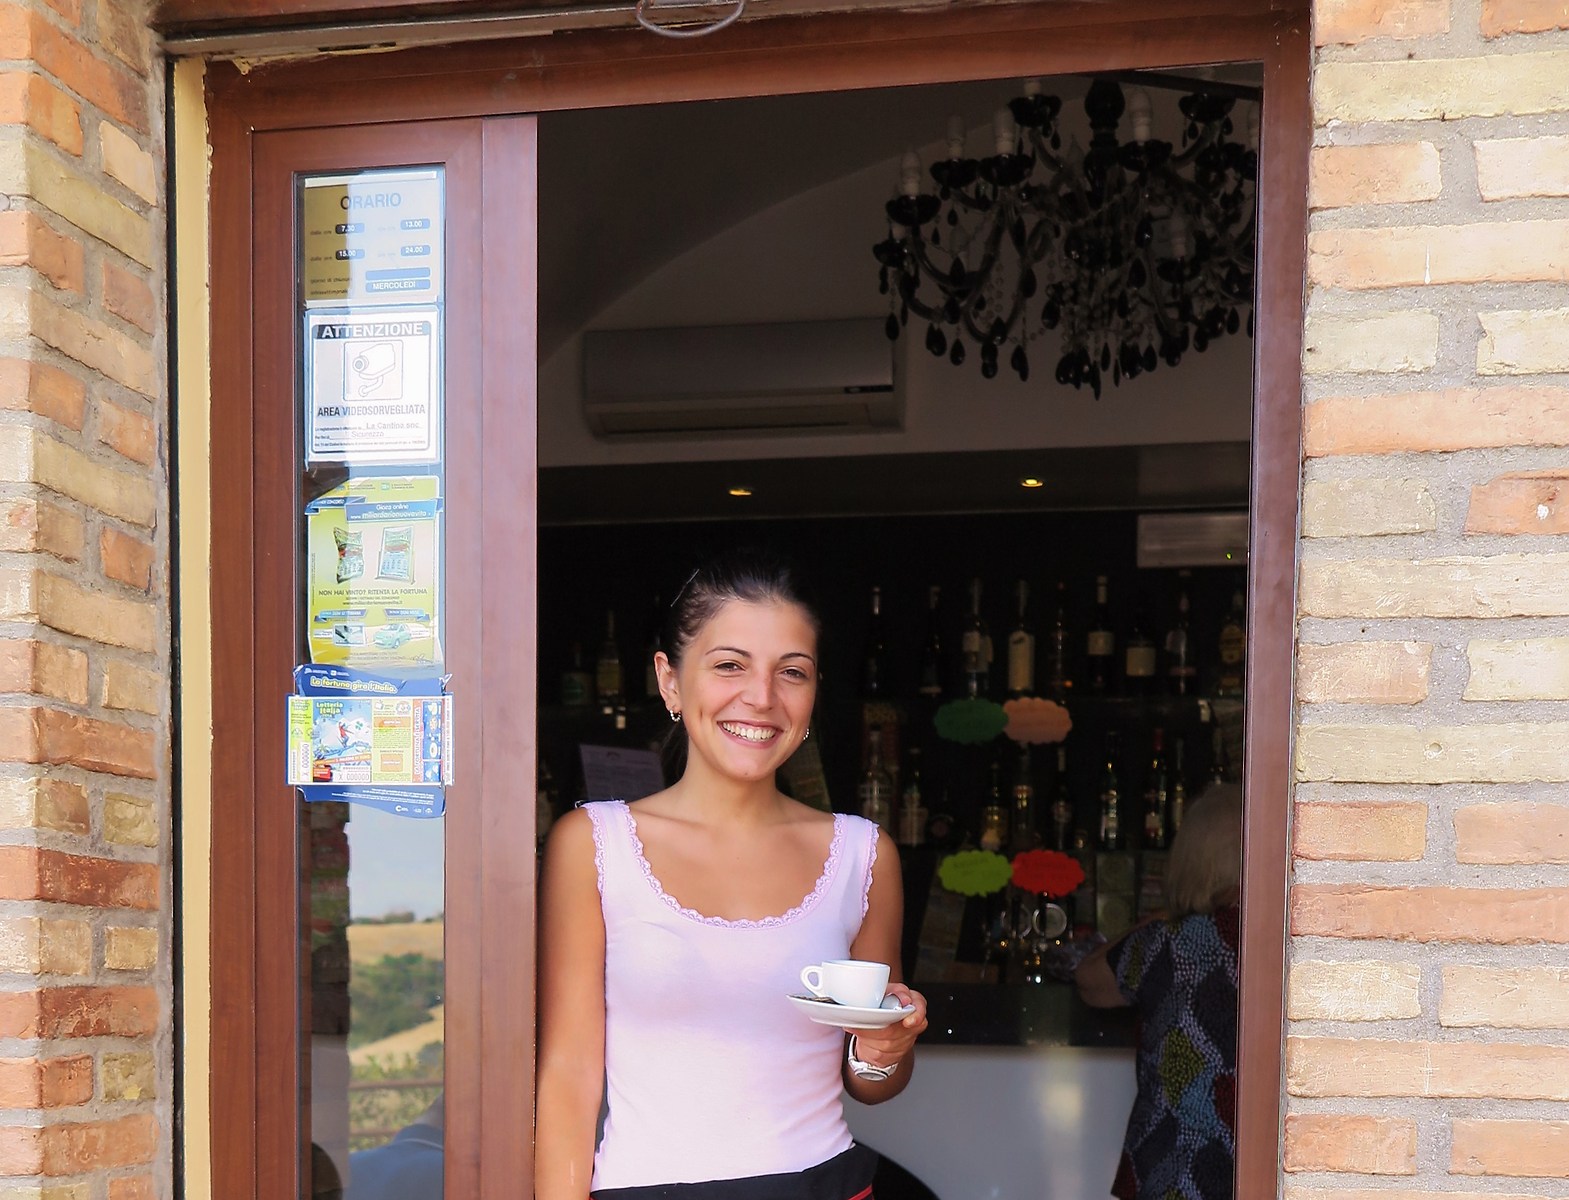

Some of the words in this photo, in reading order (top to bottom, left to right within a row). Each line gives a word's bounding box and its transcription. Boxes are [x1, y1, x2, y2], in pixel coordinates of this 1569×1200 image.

[340, 192, 402, 210] ORARIO
[405, 220, 423, 228] 13.00
[405, 246, 423, 254] 24.00
[322, 323, 423, 338] ATTENZIONE
[317, 406, 341, 417] AREA
[342, 404, 426, 416] VIDEOSORVEGLIATA
[311, 677, 321, 686] La
[322, 678, 351, 688] fortuna
[351, 682, 369, 691] gira
